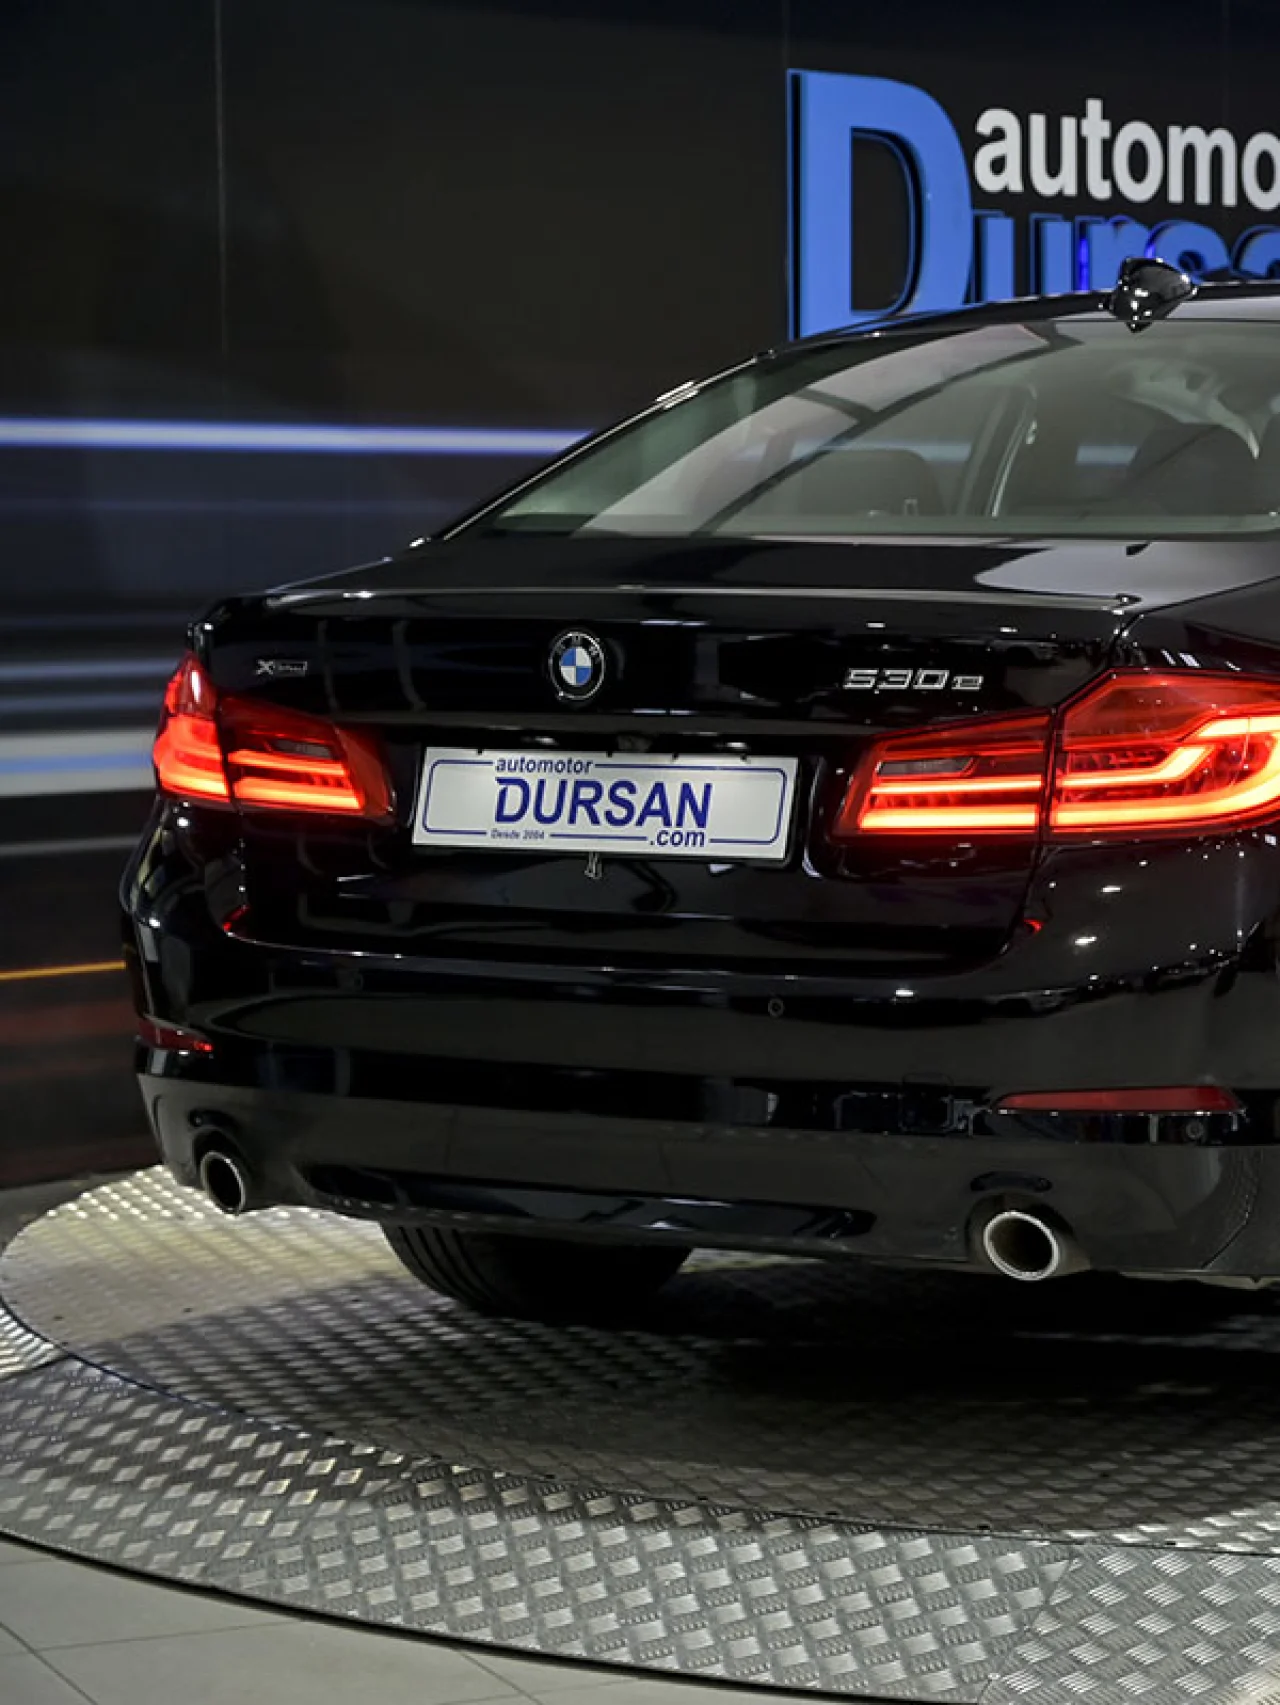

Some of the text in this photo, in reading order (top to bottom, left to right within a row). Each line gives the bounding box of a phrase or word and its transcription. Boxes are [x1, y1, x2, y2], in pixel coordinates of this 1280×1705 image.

[495, 757, 593, 774] automotor
[495, 777, 713, 829] DURSAN
[649, 829, 705, 847] .com
